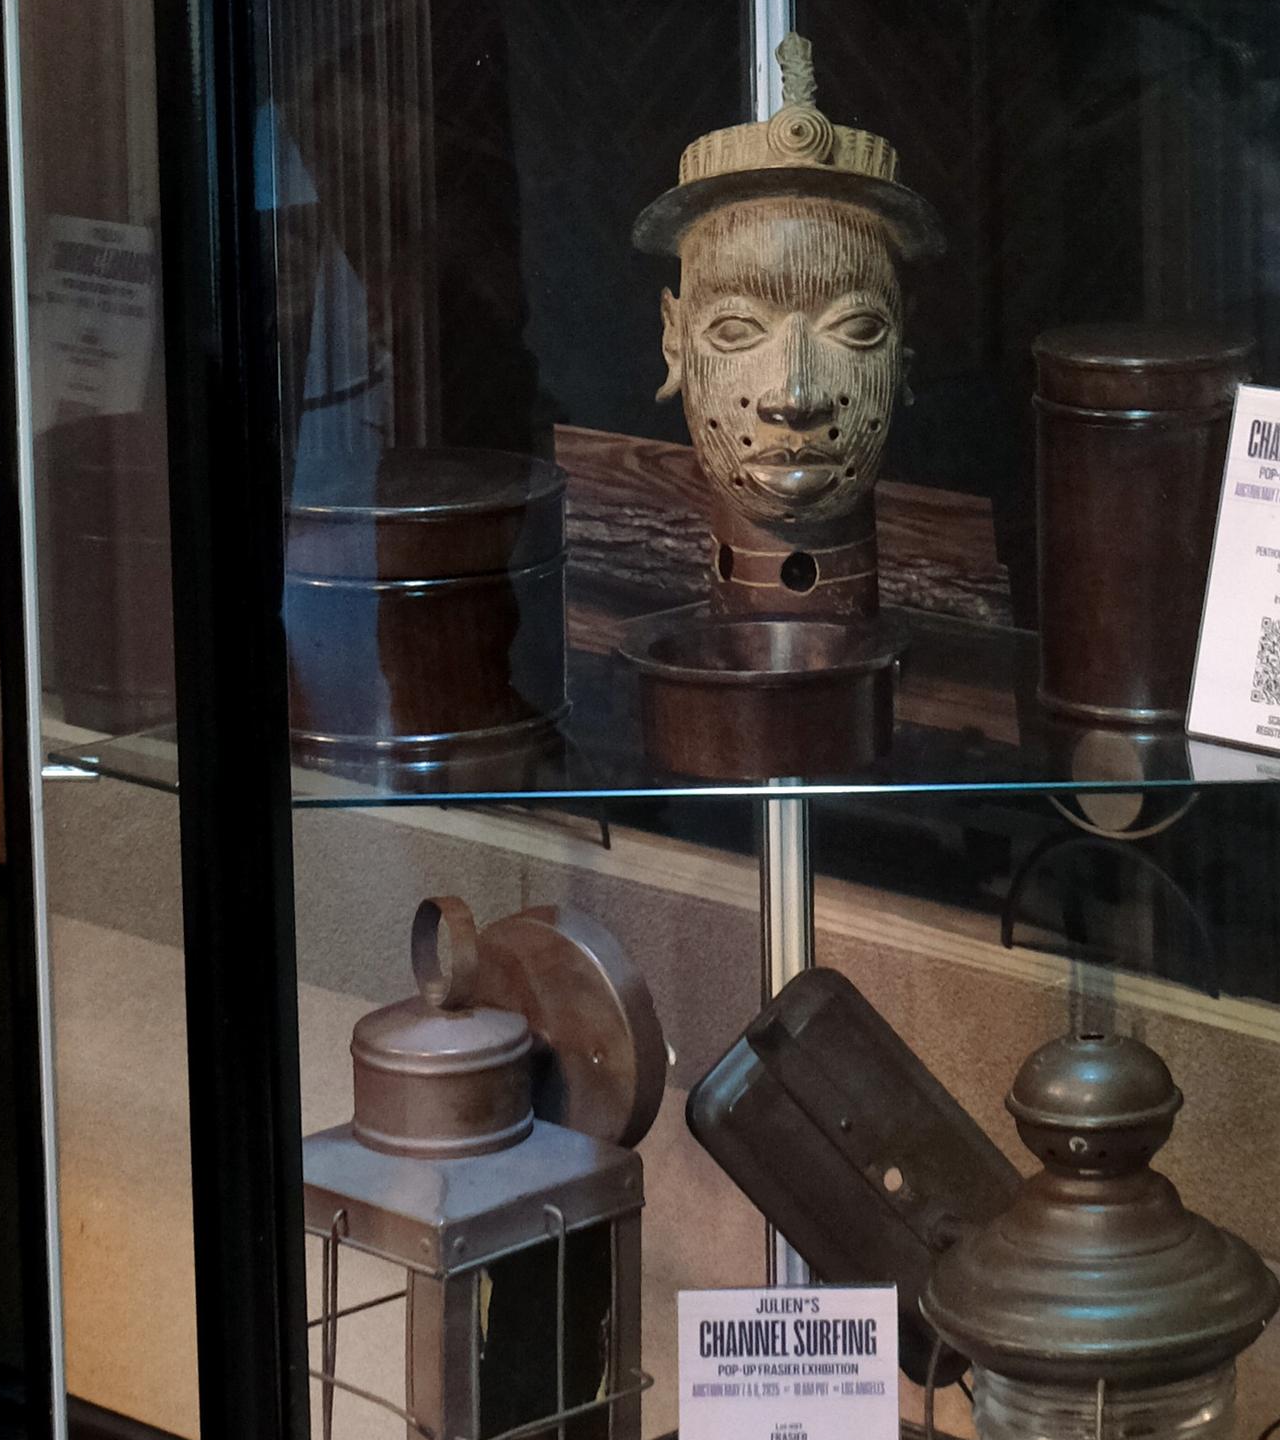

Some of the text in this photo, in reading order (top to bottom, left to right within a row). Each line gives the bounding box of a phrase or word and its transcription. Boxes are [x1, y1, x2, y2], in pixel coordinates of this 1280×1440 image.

[699, 1318, 877, 1358] CHANNEL SURFING
[718, 1362, 859, 1376] POP-UP FRASIER EXHIBITION
